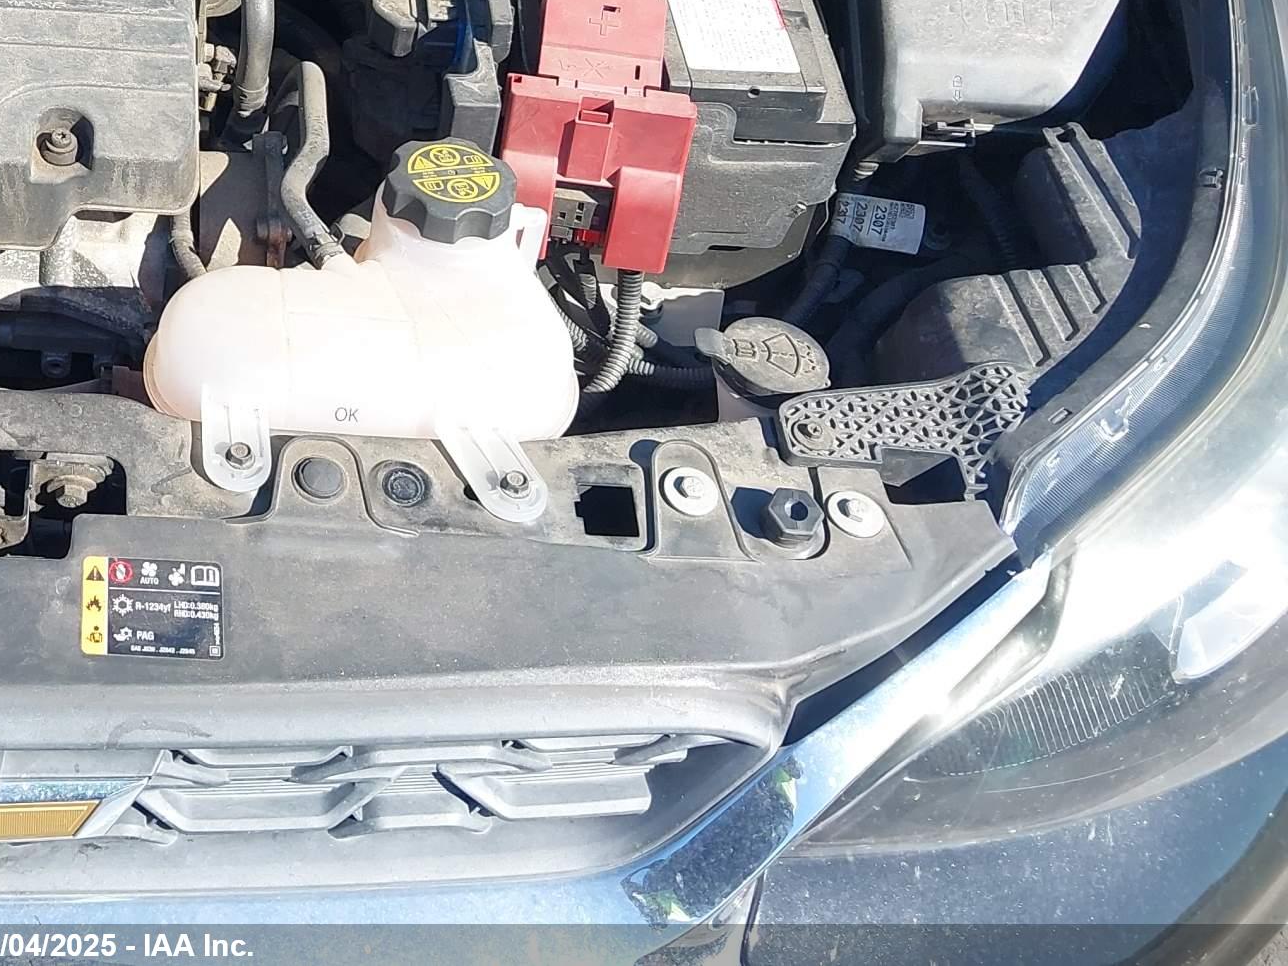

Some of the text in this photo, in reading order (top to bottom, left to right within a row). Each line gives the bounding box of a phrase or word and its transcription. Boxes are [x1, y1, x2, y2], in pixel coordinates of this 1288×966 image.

[853, 202, 868, 233] 2307
[871, 204, 888, 236] 2307
[334, 406, 359, 423] OK
[140, 576, 159, 585] AUTO
[135, 602, 172, 614] R-1234yf
[136, 630, 155, 641] PAG
